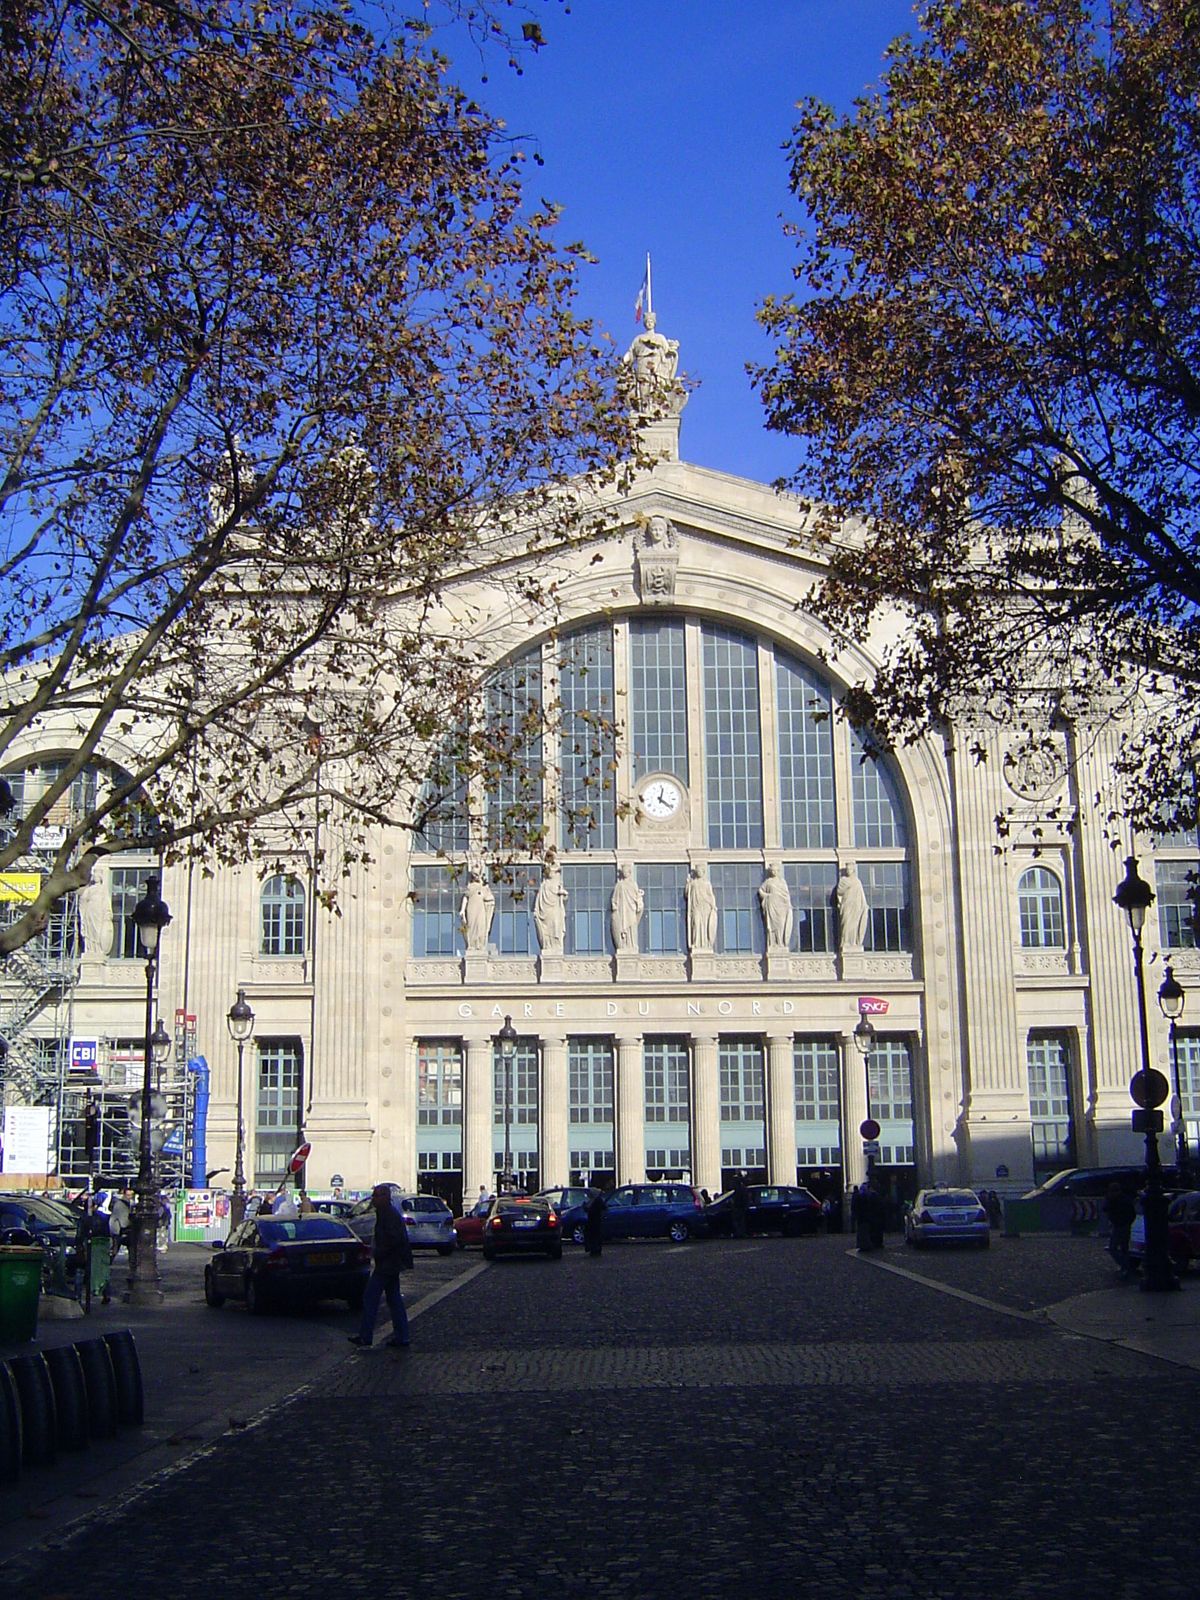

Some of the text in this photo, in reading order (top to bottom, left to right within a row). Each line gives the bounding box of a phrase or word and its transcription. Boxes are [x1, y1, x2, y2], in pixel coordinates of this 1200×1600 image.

[458, 1000, 795, 1017] GARE DU NORD
[860, 1002, 889, 1012] SNCF
[73, 1047, 95, 1060] CBI
